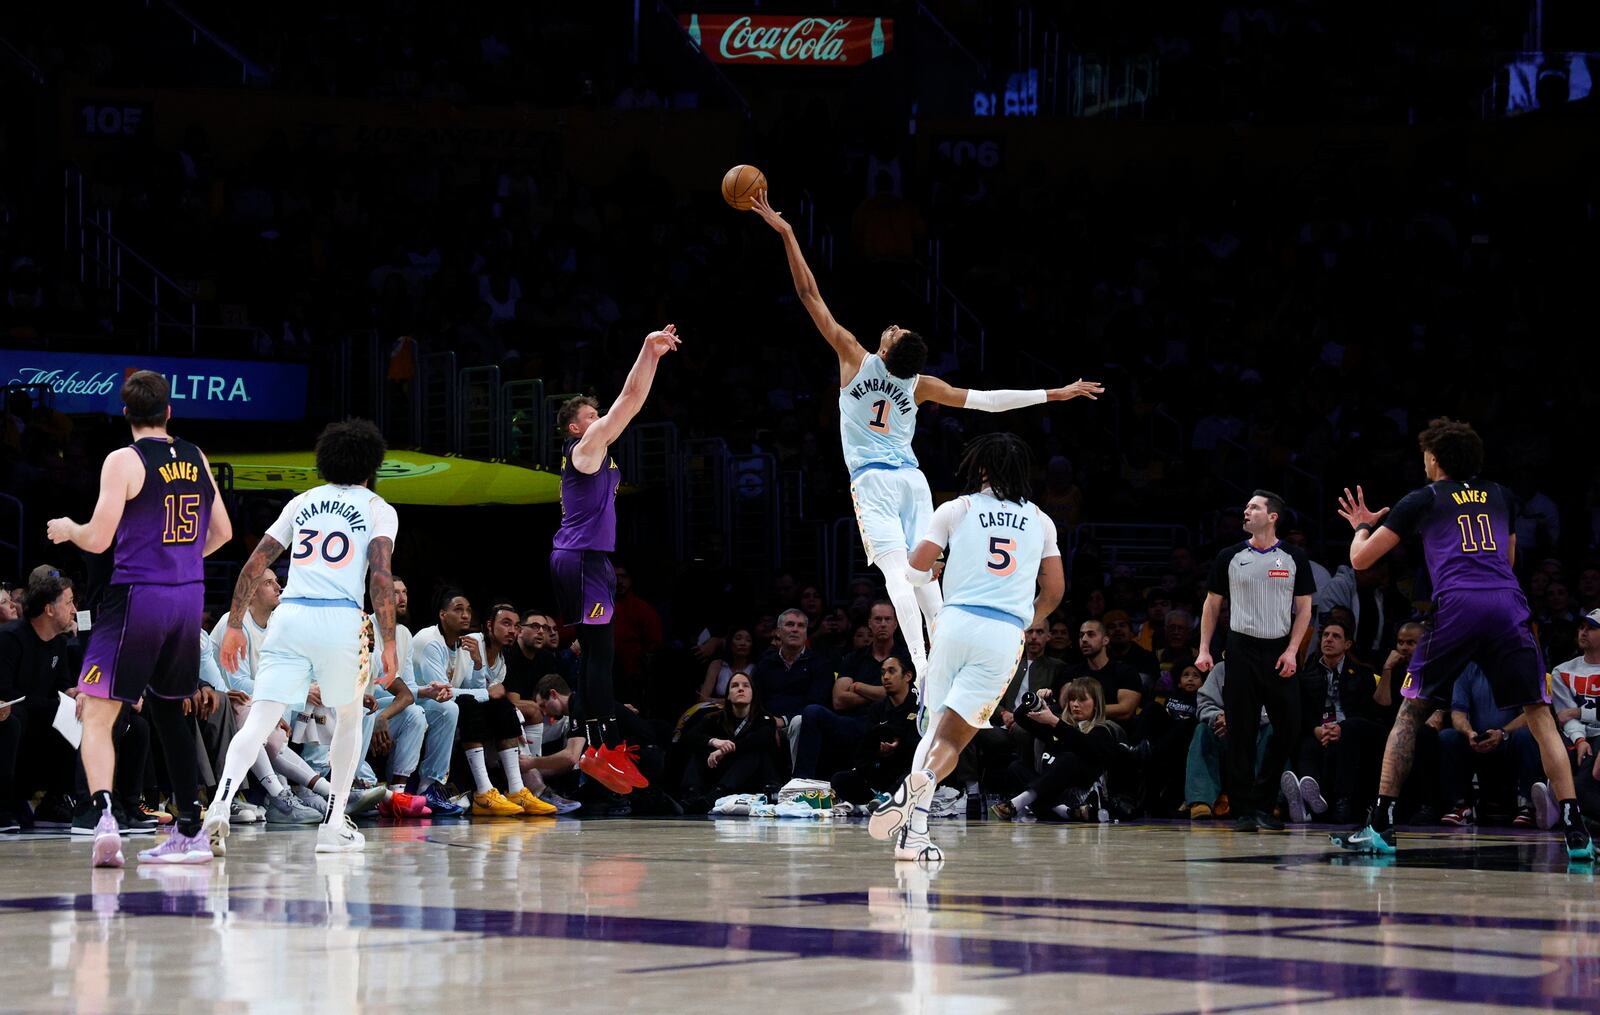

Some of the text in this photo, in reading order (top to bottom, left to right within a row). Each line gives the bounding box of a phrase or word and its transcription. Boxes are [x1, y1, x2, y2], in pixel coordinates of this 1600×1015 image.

[720, 16, 852, 61] Coca-Cola
[8, 367, 249, 402] Michelob LTRA
[850, 378, 912, 416] WEMBANYAMA
[869, 399, 889, 431] 1
[159, 461, 198, 483] REAVES
[1451, 489, 1488, 505] HAYES
[163, 494, 200, 543] 15
[295, 500, 367, 533] CHAMPAGNIE
[979, 511, 1029, 532] CASTLE
[1457, 513, 1497, 552] 11
[292, 528, 354, 567] 30
[987, 536, 1014, 574] 5
